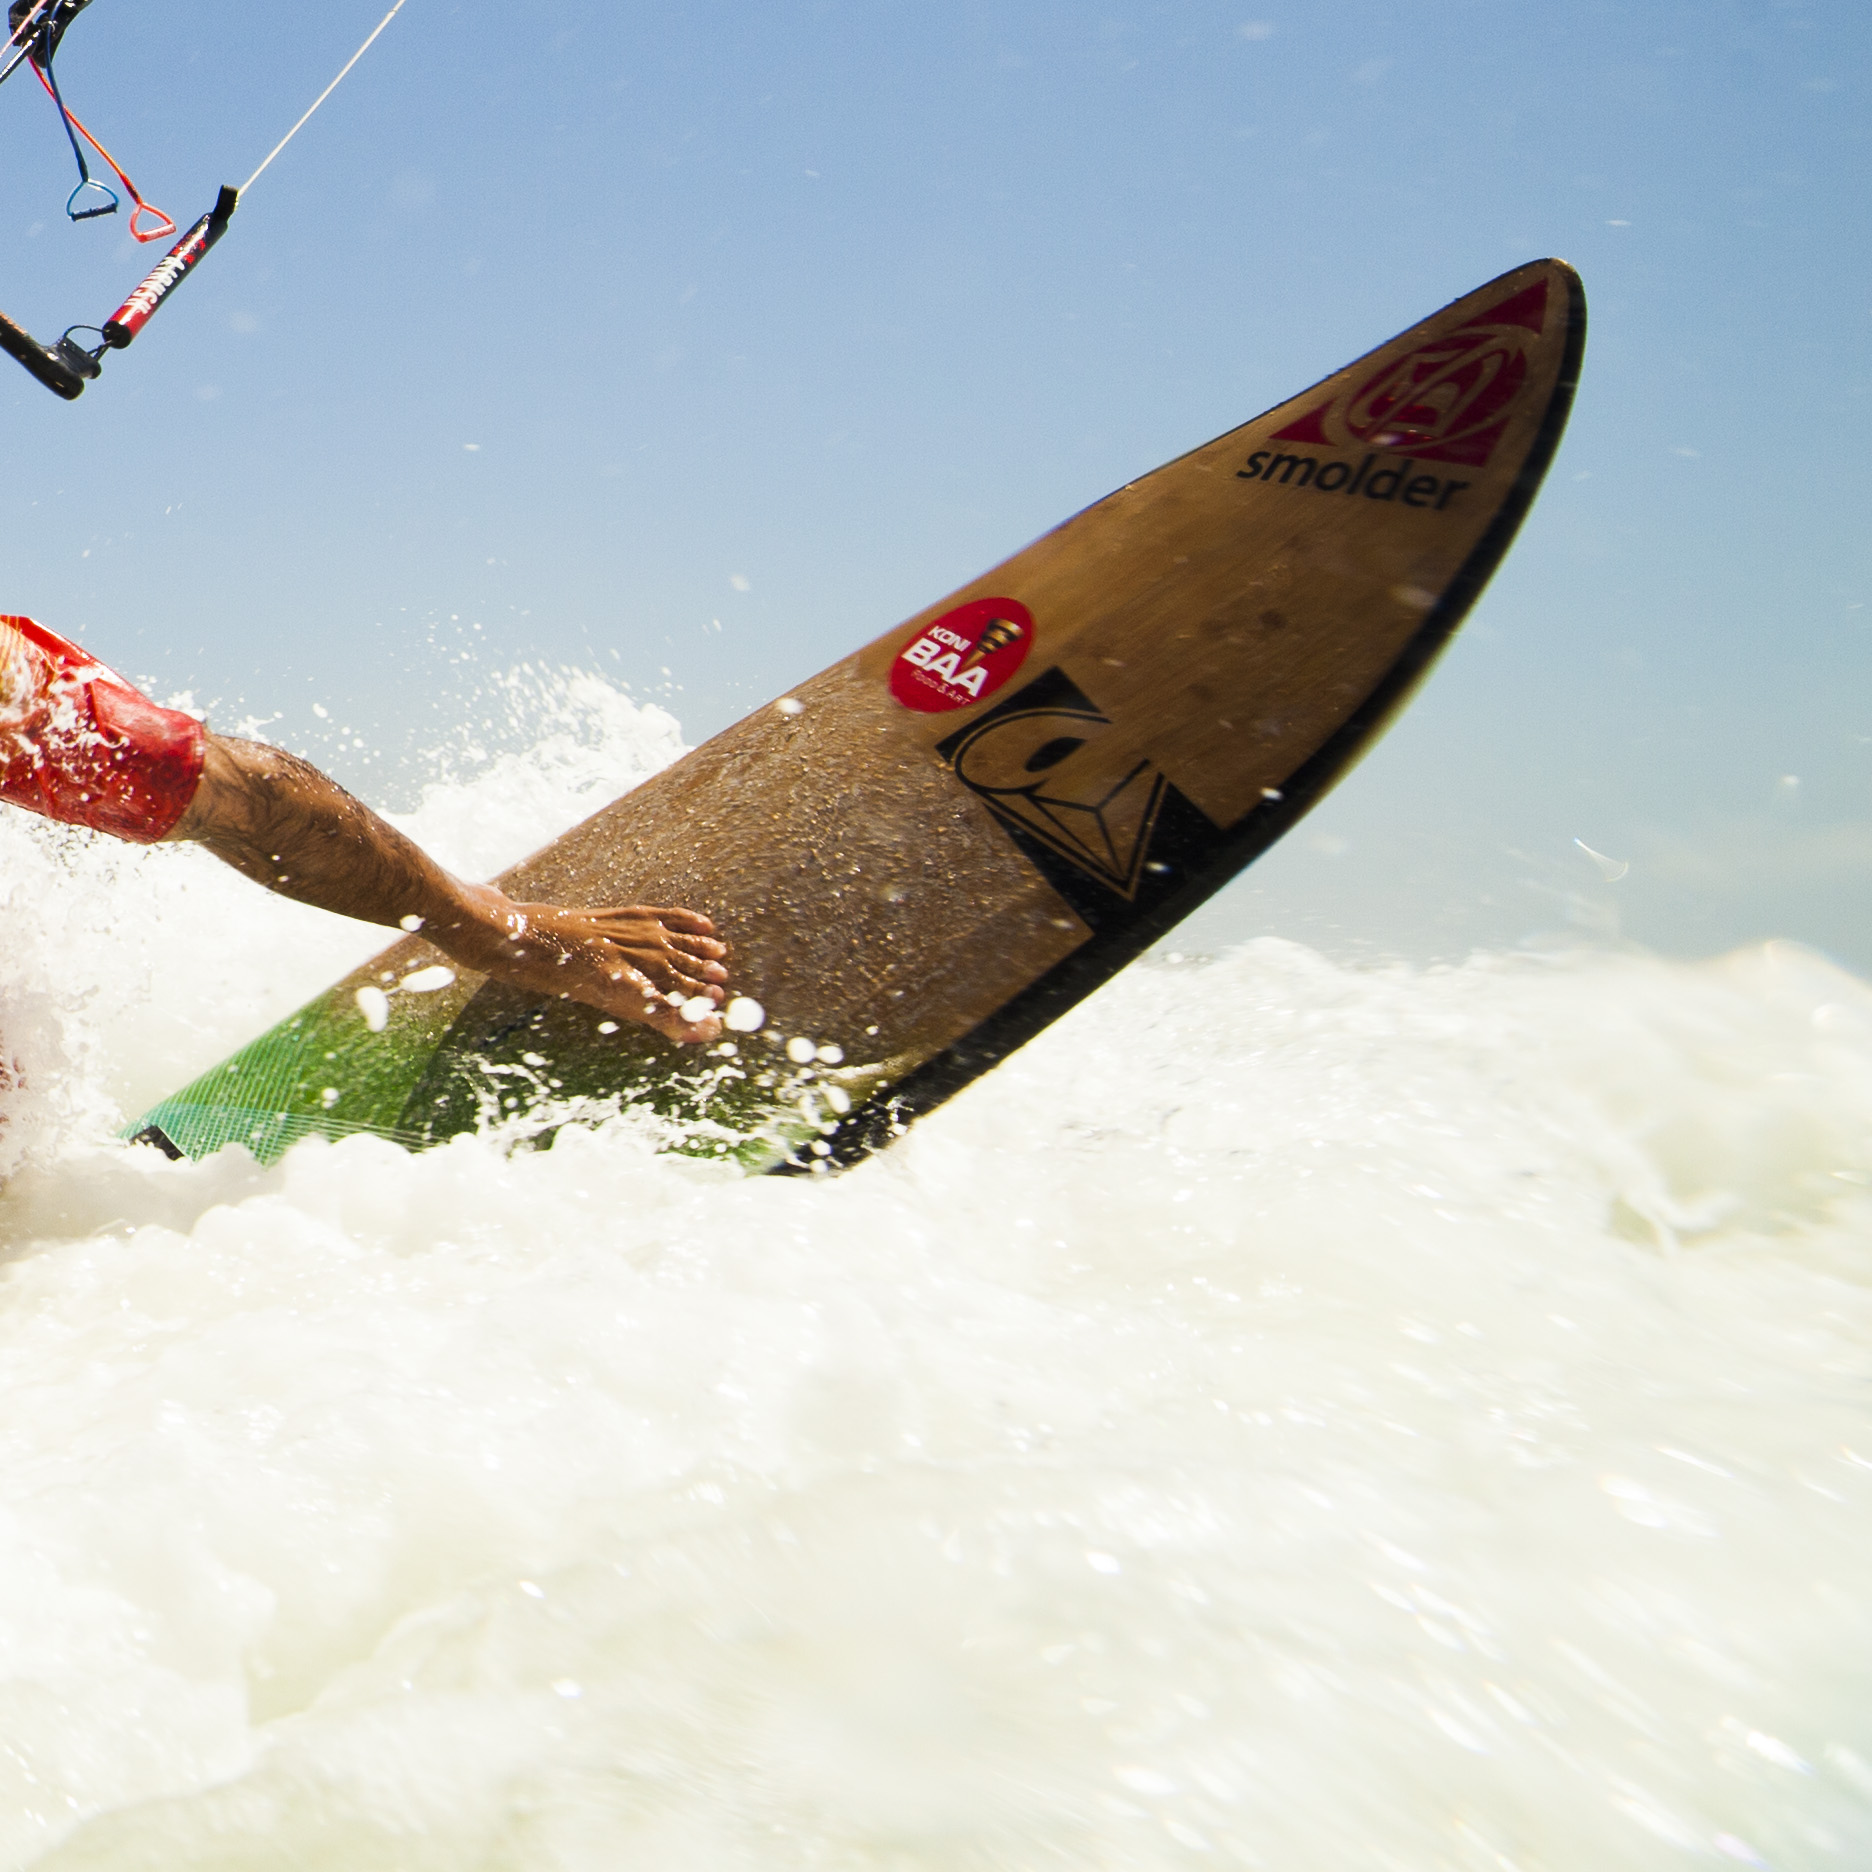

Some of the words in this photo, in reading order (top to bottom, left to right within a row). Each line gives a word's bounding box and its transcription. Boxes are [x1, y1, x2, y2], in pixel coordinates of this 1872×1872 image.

[1236, 450, 1471, 510] smolder
[902, 638, 988, 697] BAA
[928, 626, 971, 651] KONI
